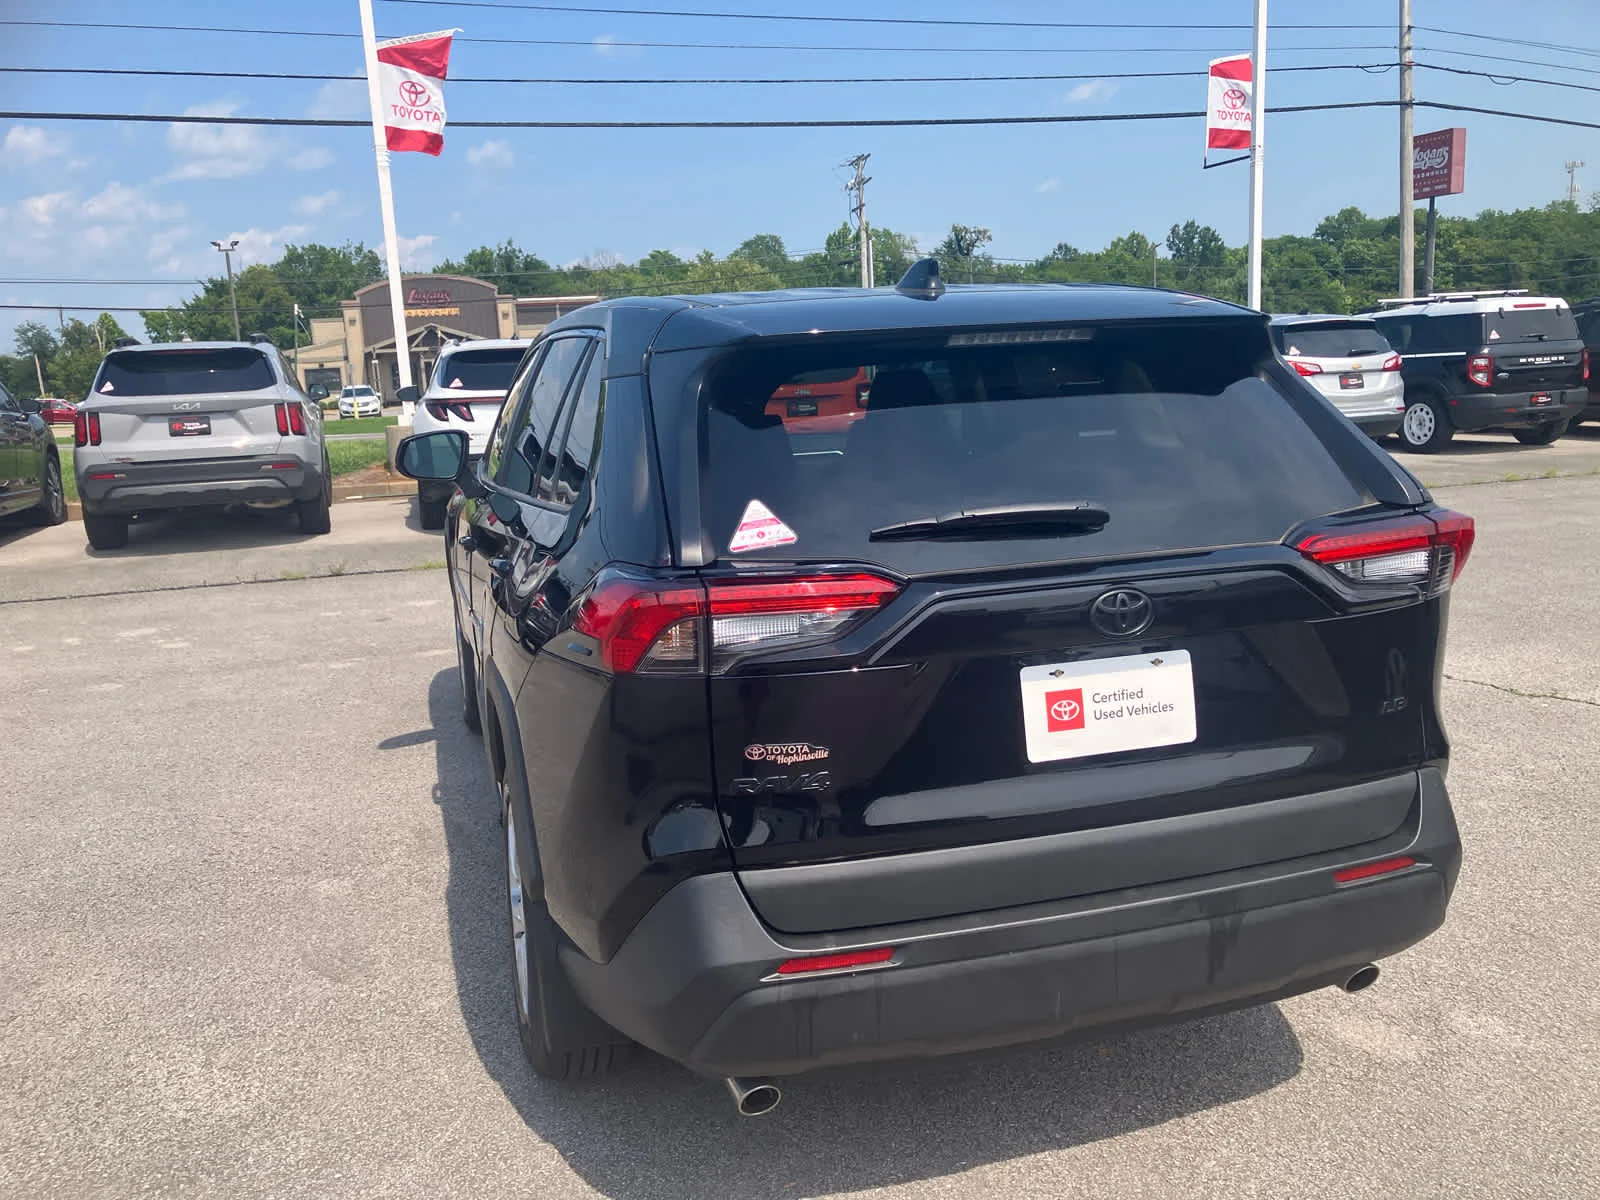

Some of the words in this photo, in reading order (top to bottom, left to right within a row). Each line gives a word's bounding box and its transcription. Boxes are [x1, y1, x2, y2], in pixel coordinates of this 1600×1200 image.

[391, 104, 441, 122] TOYOTA
[1217, 110, 1252, 122] TOYOTA
[1092, 688, 1144, 704] Certified
[1093, 706, 1124, 721] Used
[1126, 702, 1174, 717] Vehicles
[766, 745, 810, 755] TOYOTA
[776, 750, 829, 765] Hopkinsville
